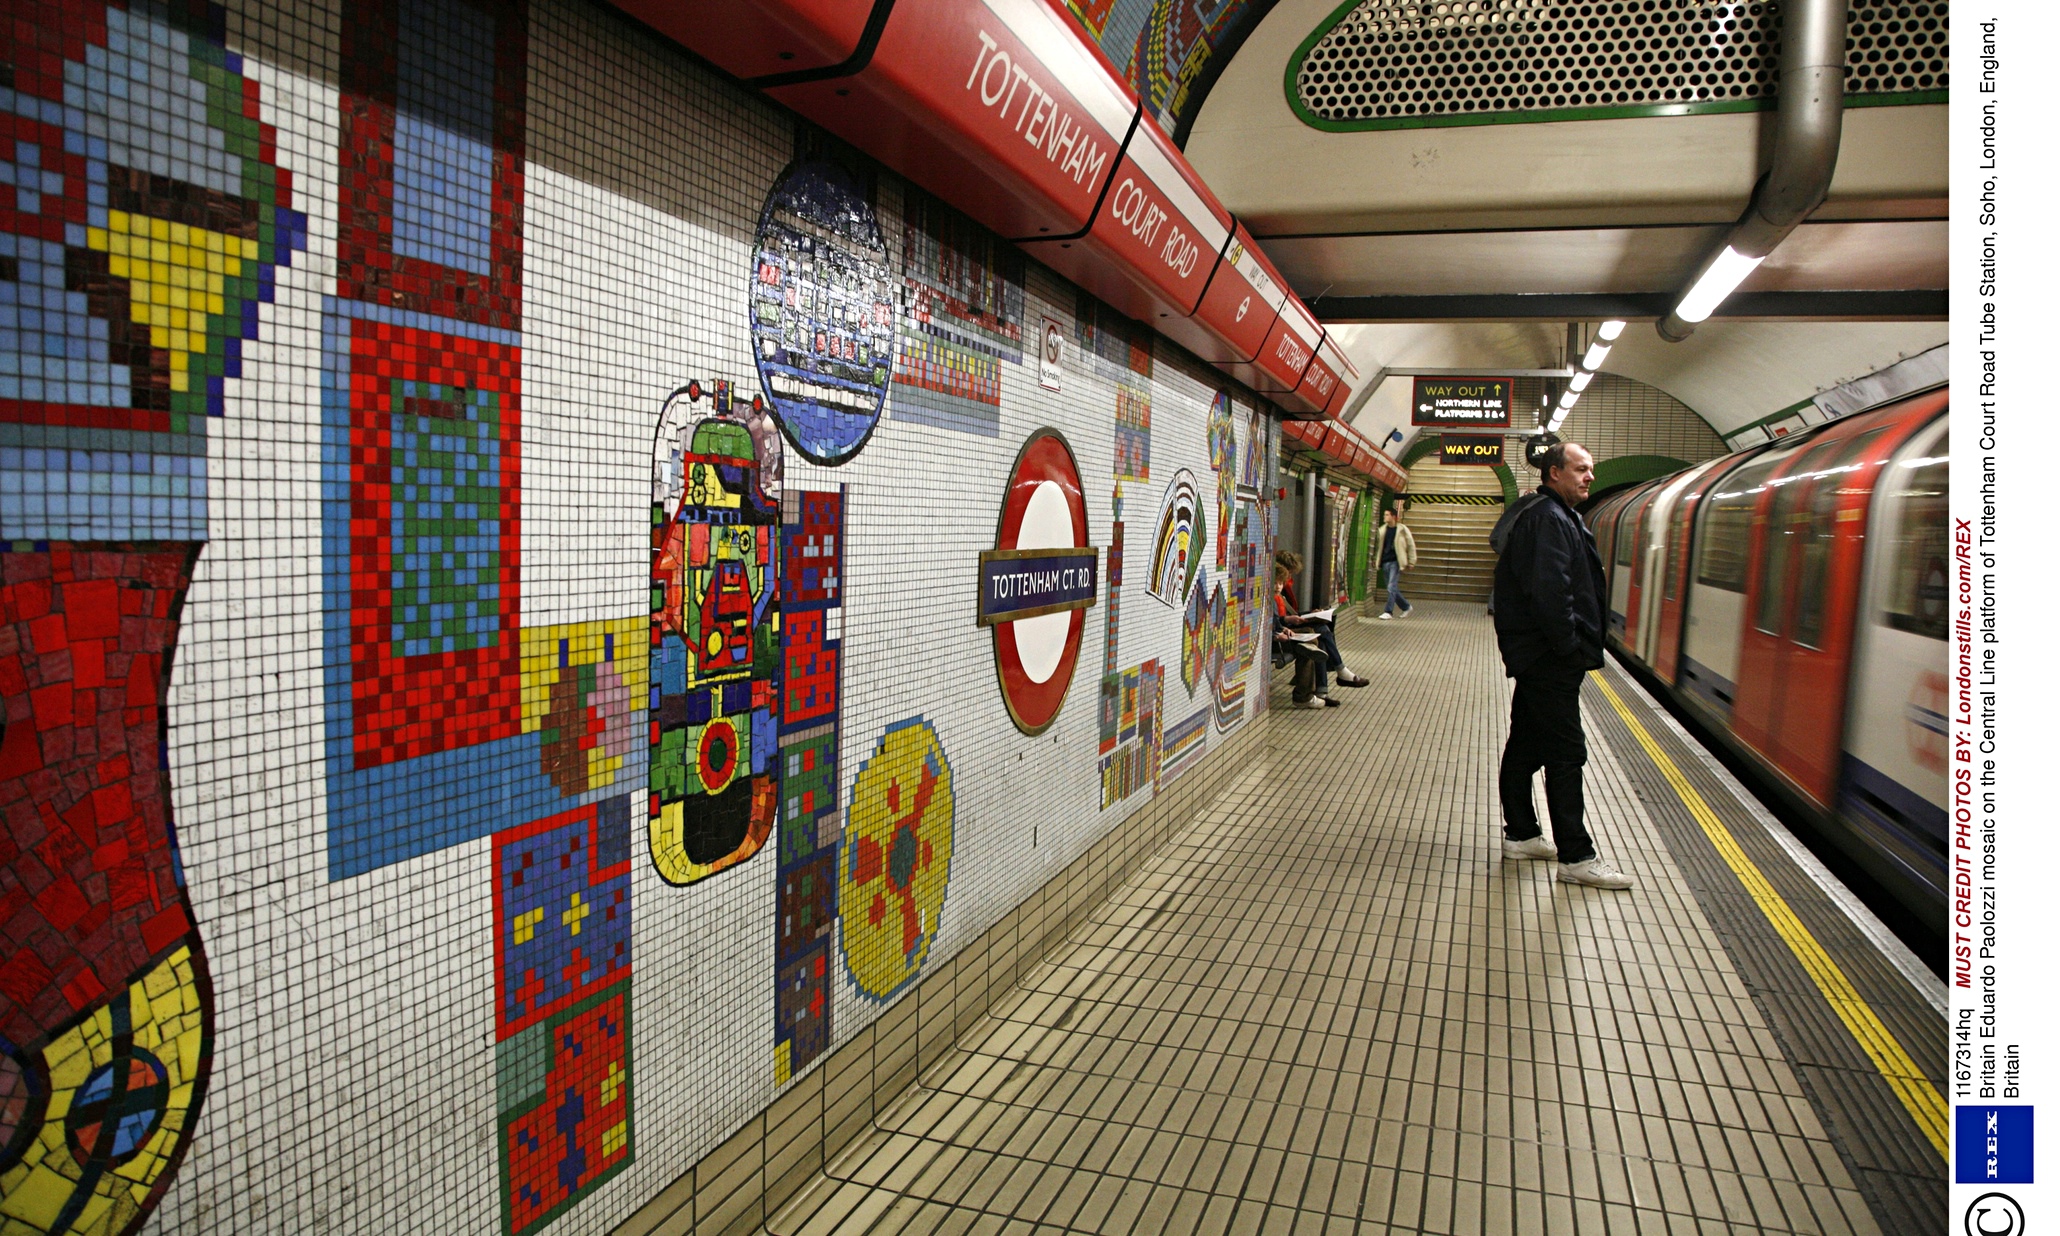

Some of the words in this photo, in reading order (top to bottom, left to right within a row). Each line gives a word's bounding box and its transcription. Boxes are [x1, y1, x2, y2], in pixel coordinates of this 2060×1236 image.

[966, 29, 1107, 194] TOTTENHAM
[1112, 177, 1168, 248] COURT
[1160, 225, 1198, 279] ROAD
[1257, 274, 1269, 291] OUT
[1275, 333, 1310, 376] TOTTENHAM
[1305, 362, 1325, 388] COURT
[1425, 386, 1453, 396] WAY
[1458, 386, 1486, 396] OUT
[1435, 399, 1480, 408] NORTHERN
[1483, 399, 1502, 408] LINE
[1435, 409, 1482, 418] PLATFORMS
[1484, 409, 1490, 418] 3
[1491, 410, 1498, 418] &
[1499, 410, 1505, 418] 4
[1445, 445, 1471, 455] WAY
[1473, 445, 1499, 455] OUT
[992, 570, 1059, 599] TOTTENHAM
[1062, 568, 1075, 590] CT.
[1078, 567, 1091, 588] RD.
